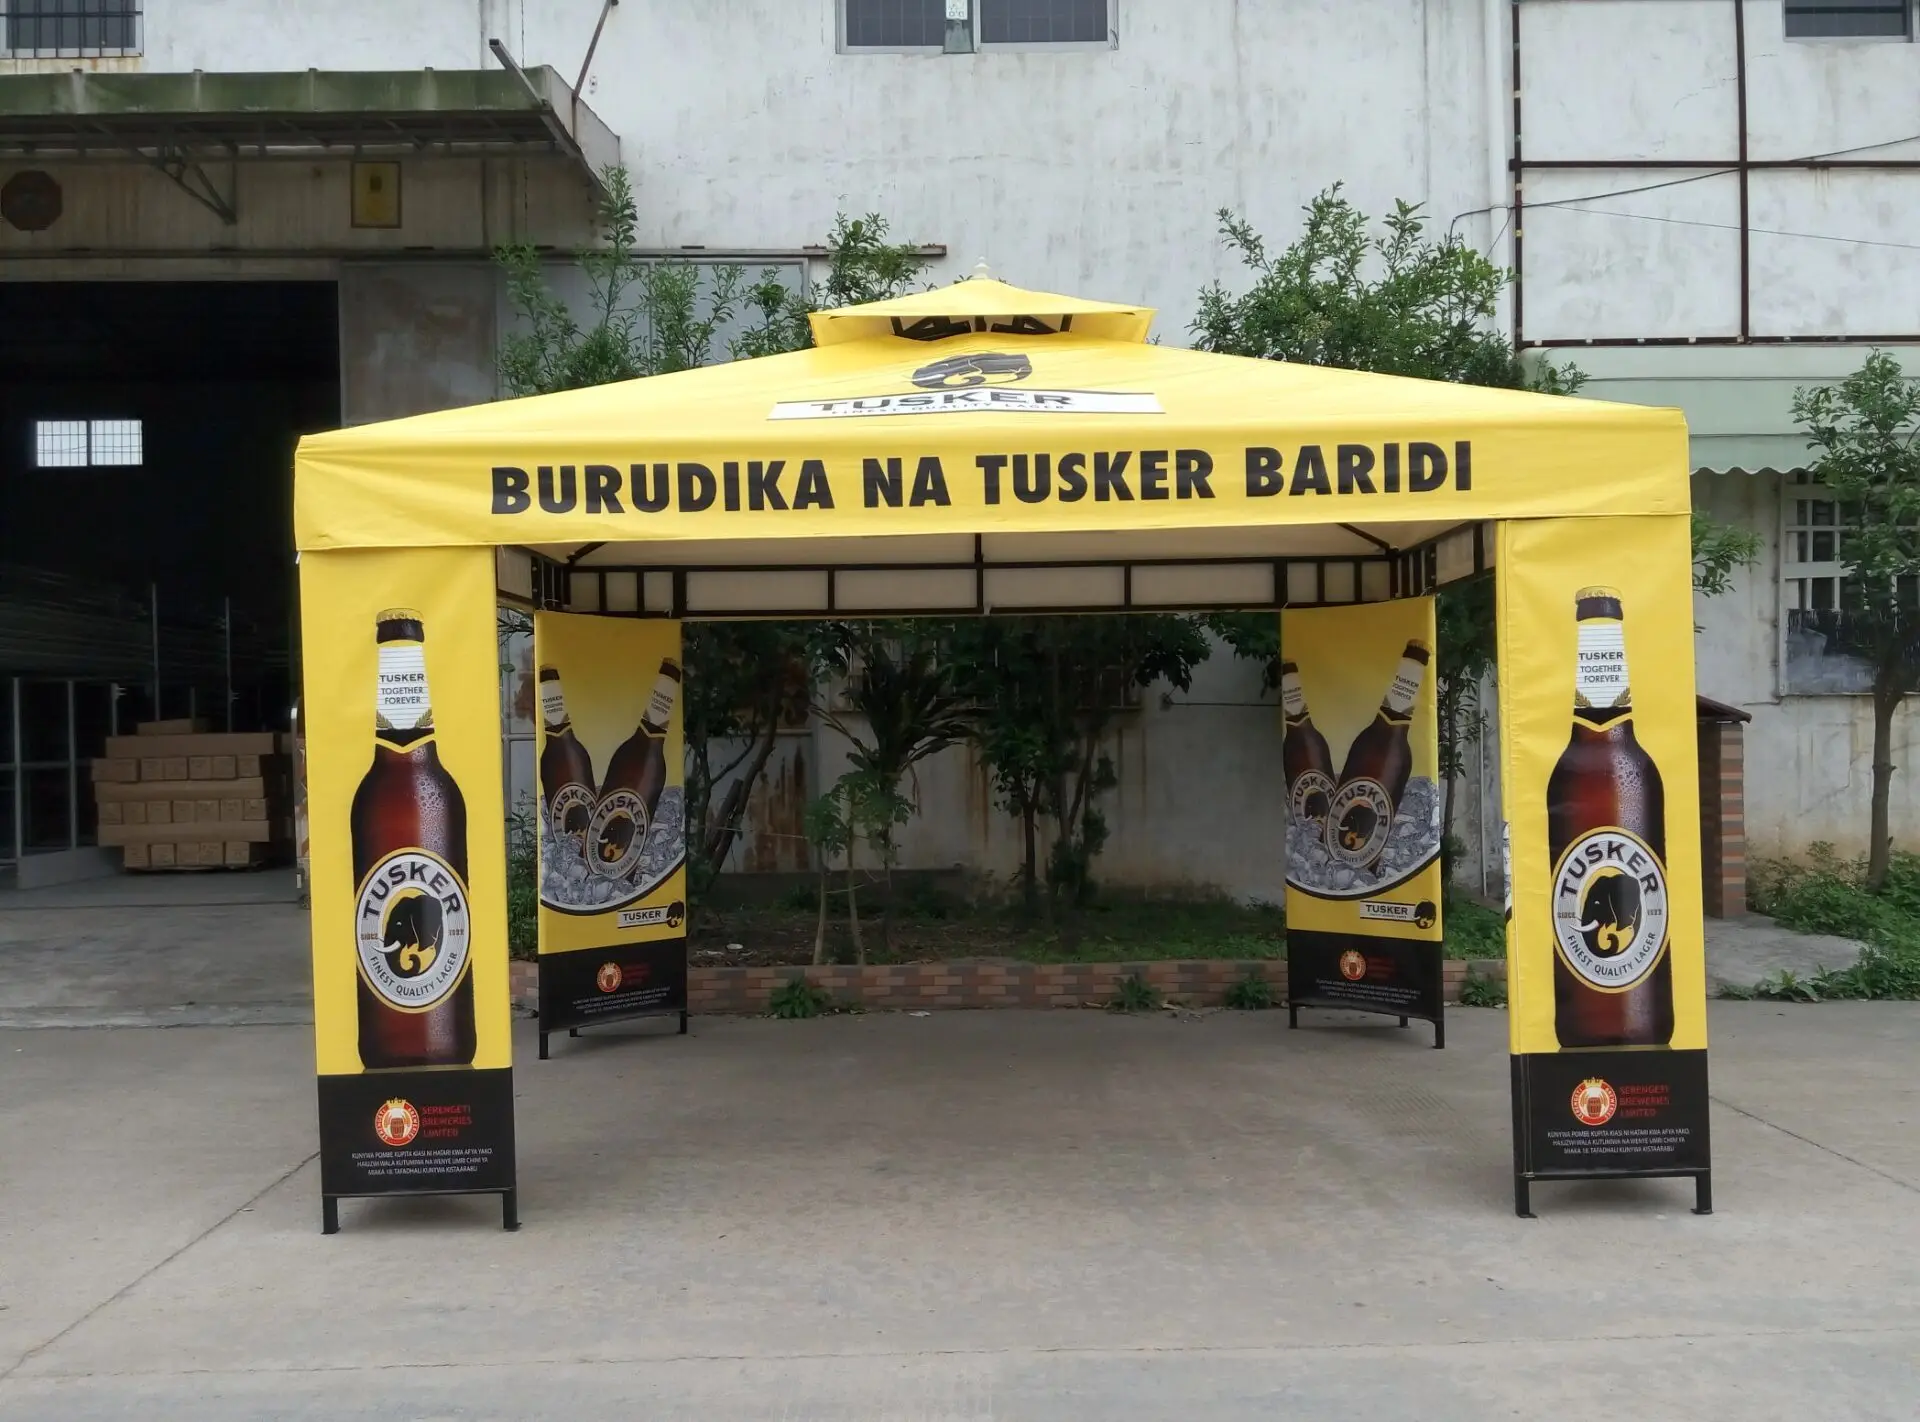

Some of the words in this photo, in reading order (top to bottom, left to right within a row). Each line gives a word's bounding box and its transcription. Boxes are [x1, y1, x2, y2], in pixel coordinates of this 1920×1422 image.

[811, 391, 1072, 411] TUSKER
[491, 459, 835, 514] BURUDIKA
[862, 456, 952, 509] NA
[975, 448, 1216, 505] TUSKER
[1245, 440, 1472, 498] BARIDI
[1578, 651, 1624, 661] TUSKER
[379, 673, 425, 683] TUSKER
[1580, 664, 1622, 673] TOGETHER
[1584, 674, 1620, 683] FOREVER
[380, 686, 423, 695] TOGETHER
[384, 696, 421, 705] FOREVER
[1294, 775, 1335, 806] TUSKER
[553, 788, 596, 823] TUSKER
[1335, 784, 1388, 827] TUSKER
[595, 795, 646, 837] TUSKER
[1560, 840, 1659, 898] TUSKER
[362, 861, 461, 919] TUSKER
[623, 910, 661, 921] TUSKER
[1366, 904, 1409, 915] TUSKER
[1568, 935, 1593, 966] FINEST
[1594, 962, 1634, 976] QUALITY
[1635, 932, 1656, 964] LAGER
[370, 956, 395, 987] FINEST
[396, 982, 435, 997] QUALITY
[437, 952, 457, 983] LAGER
[421, 1105, 471, 1115] SERENGETI
